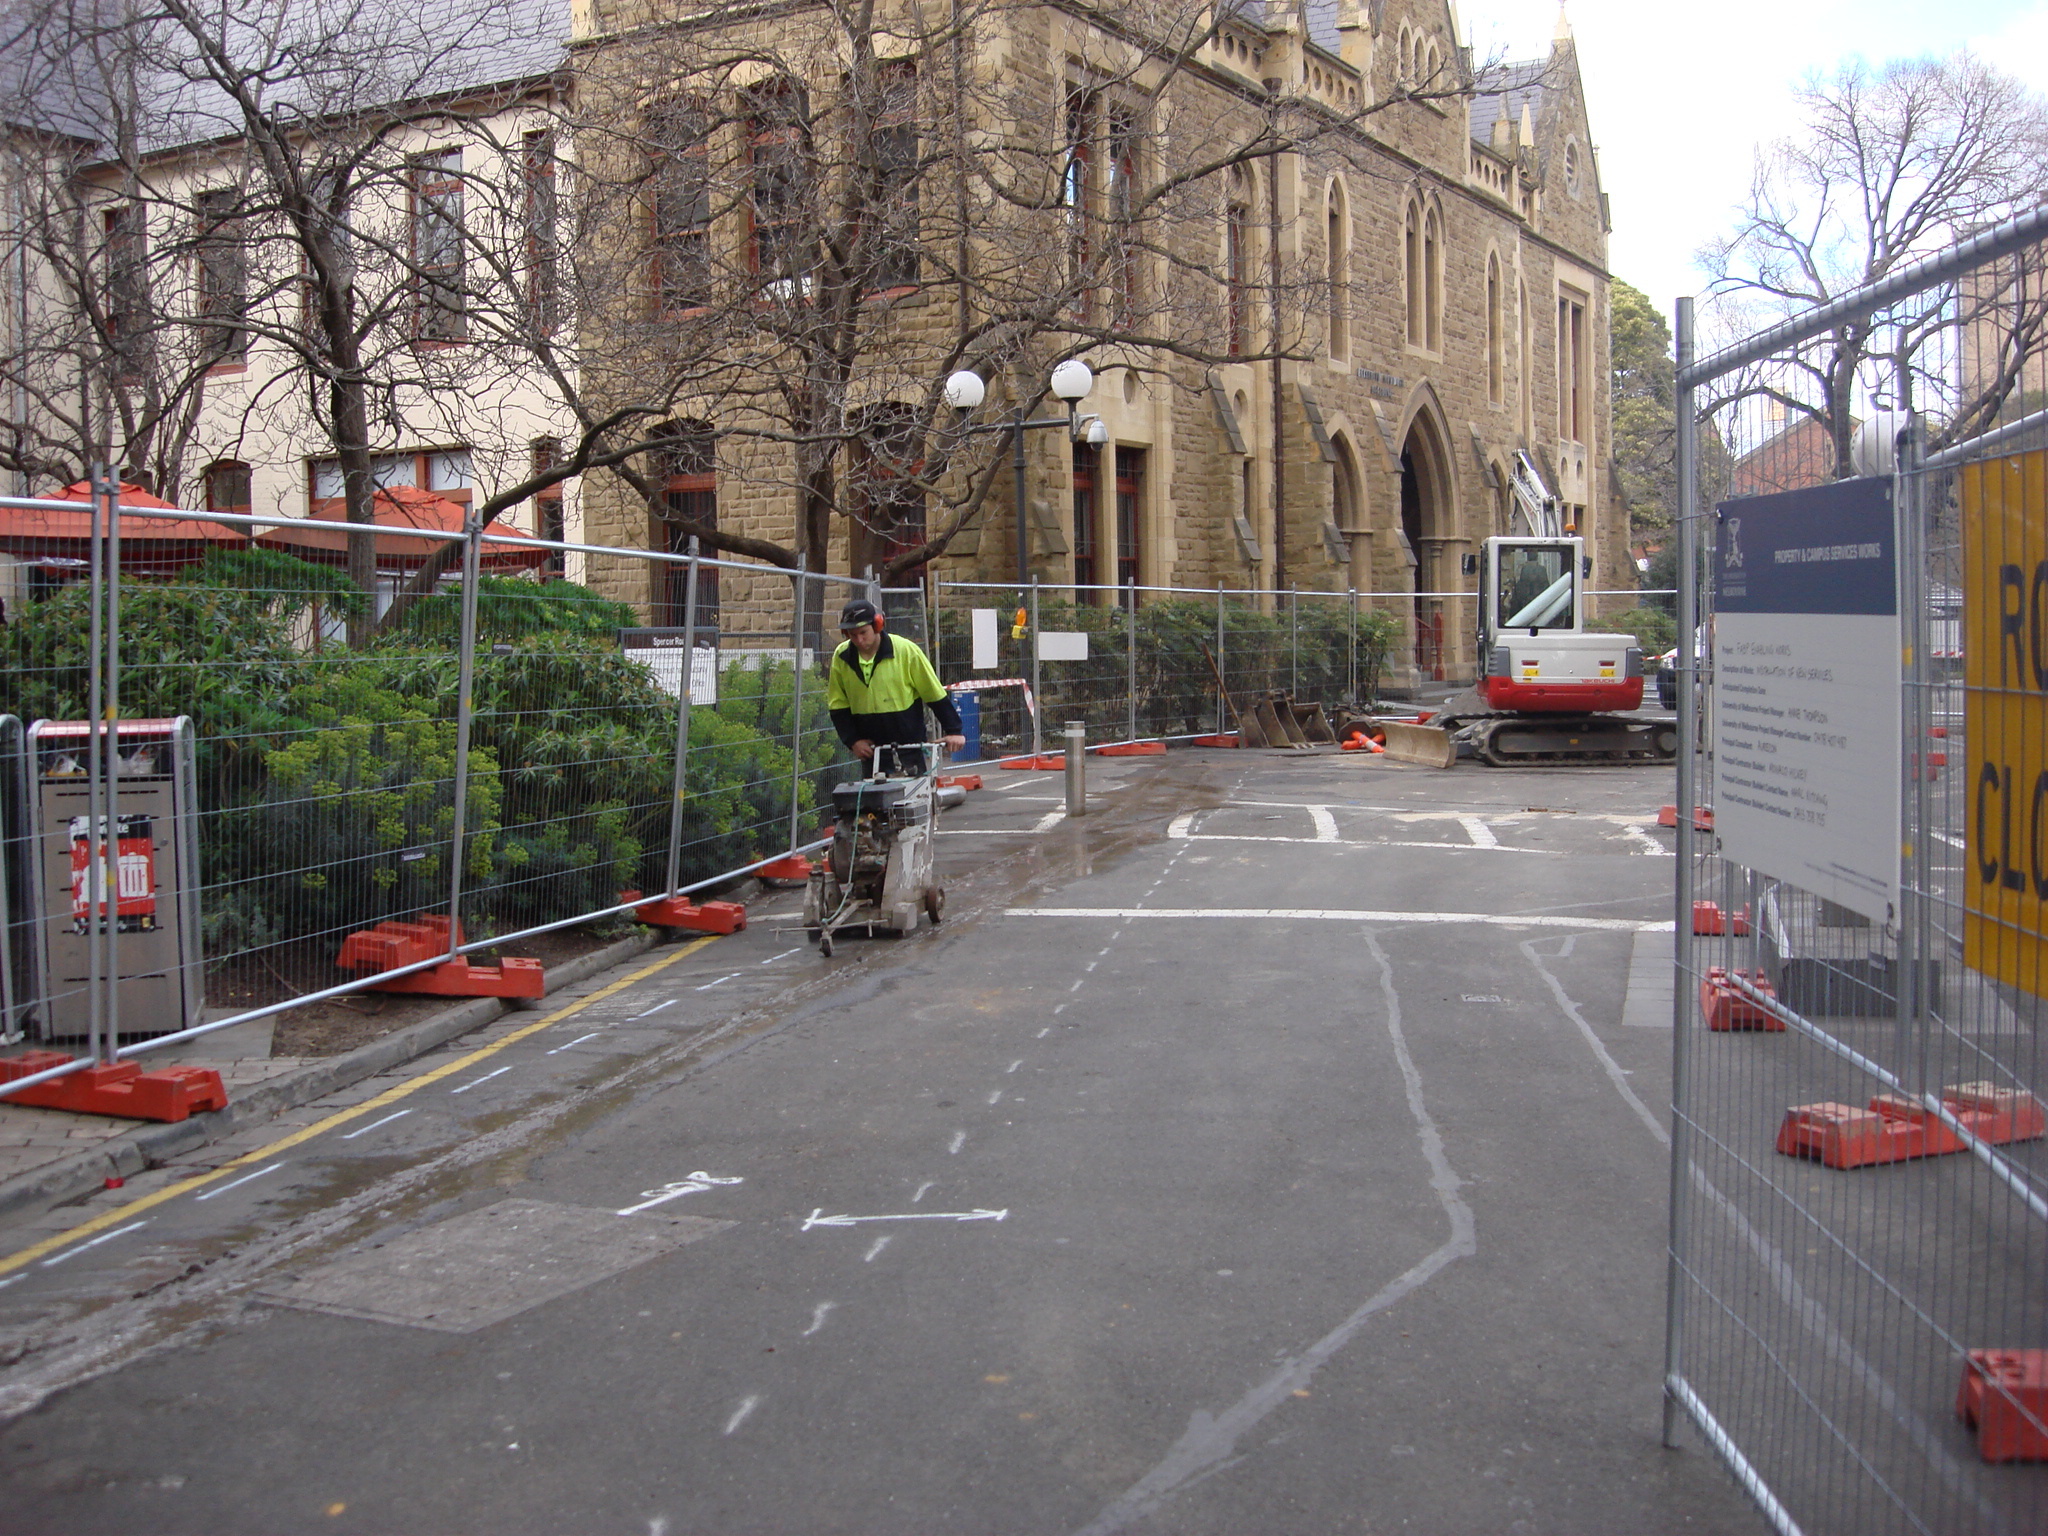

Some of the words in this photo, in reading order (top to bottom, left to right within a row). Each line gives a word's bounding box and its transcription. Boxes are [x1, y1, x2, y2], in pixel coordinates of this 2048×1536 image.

[1775, 549, 1801, 563] PROPERTY
[1802, 549, 1805, 561] &
[1806, 547, 1830, 561] CAMPUS
[1831, 545, 1857, 560] SERVICES
[1858, 543, 1880, 558] WORKS
